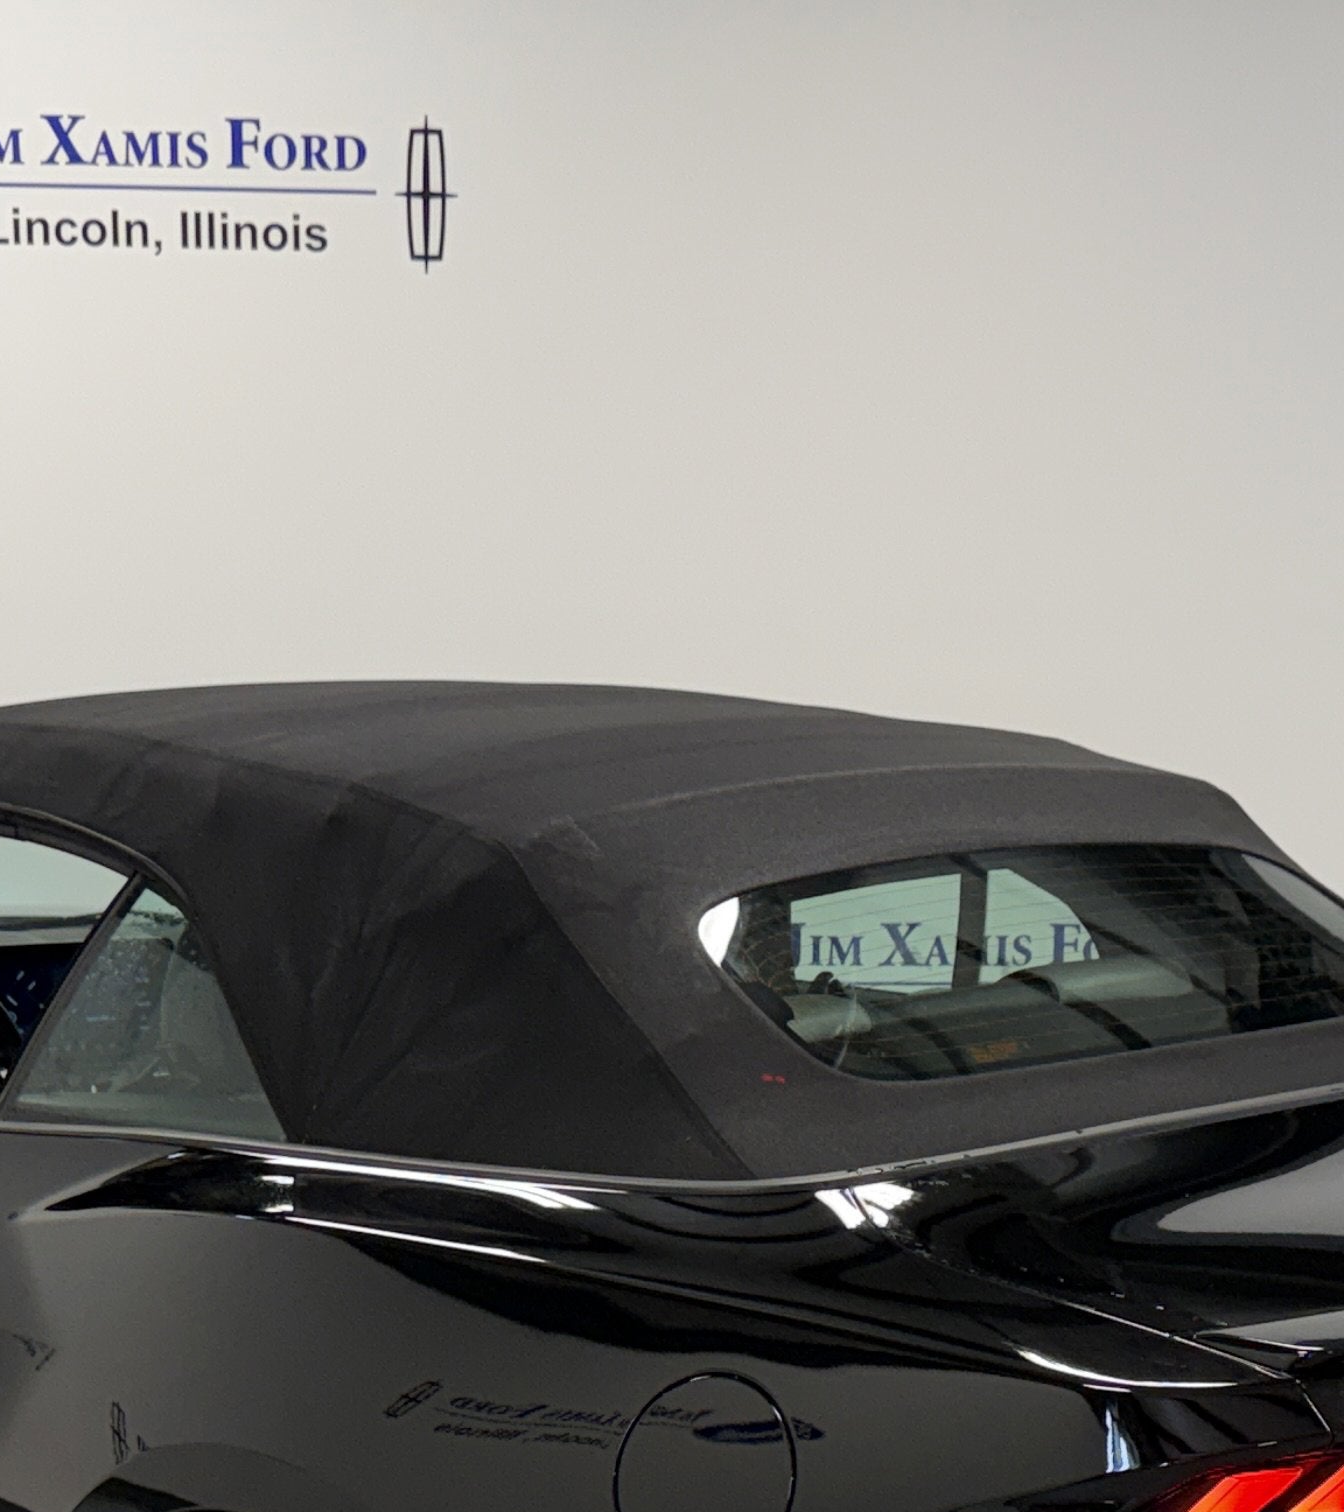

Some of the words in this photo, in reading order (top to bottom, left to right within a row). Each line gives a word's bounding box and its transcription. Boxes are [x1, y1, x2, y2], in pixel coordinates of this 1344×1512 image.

[39, 113, 208, 169] XAMIS
[224, 117, 368, 172] FORD
[180, 210, 329, 252] Illinois
[878, 922, 1032, 968] XAIS
